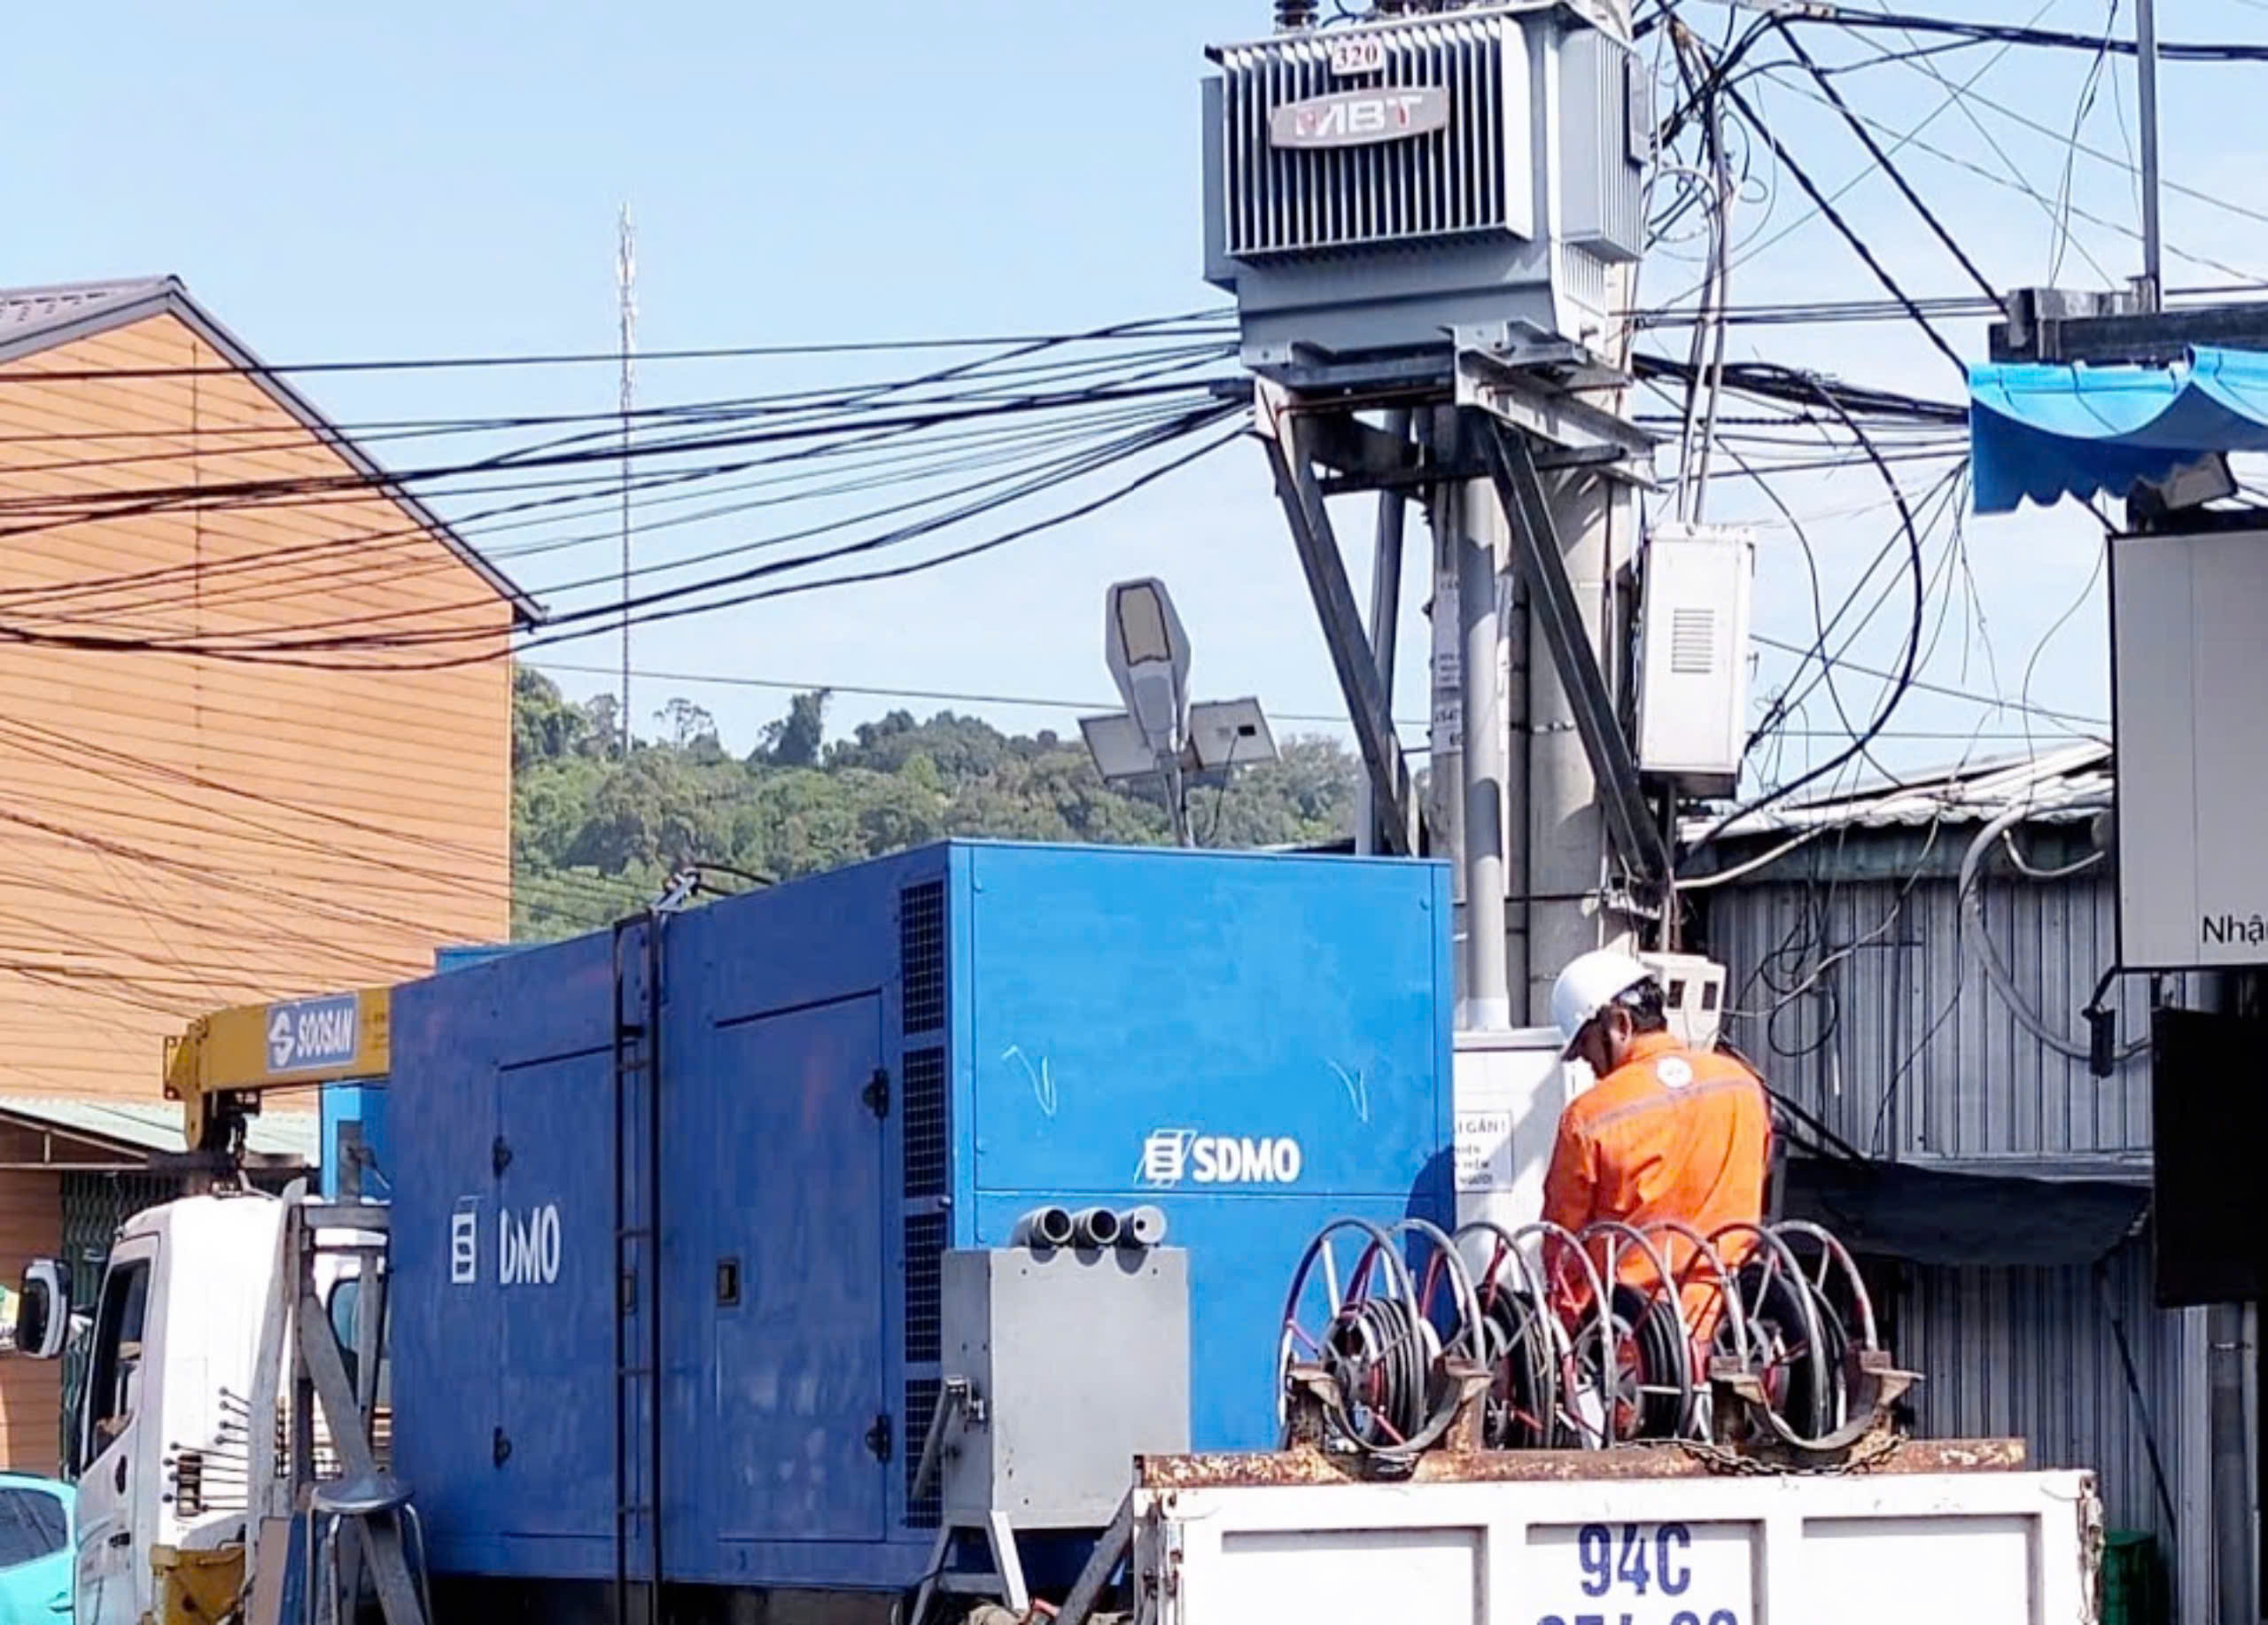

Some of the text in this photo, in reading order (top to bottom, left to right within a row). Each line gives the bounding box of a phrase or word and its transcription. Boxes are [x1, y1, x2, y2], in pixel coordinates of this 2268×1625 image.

[1336, 44, 1379, 70] 320
[2202, 914, 2268, 946] Nhậ
[297, 1008, 353, 1057] SOOSAN
[1192, 1136, 1301, 1183] SDMO
[1578, 1522, 1691, 1597] 94C
